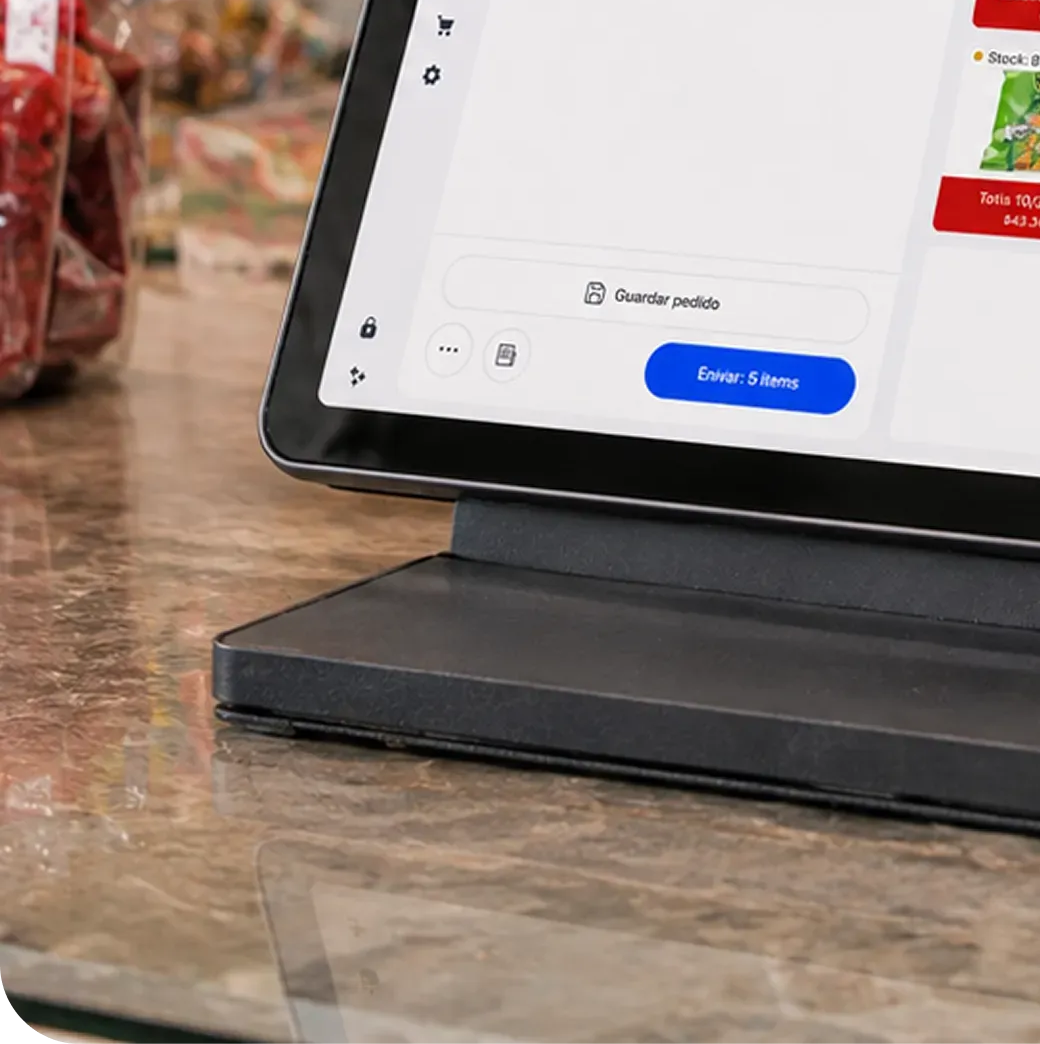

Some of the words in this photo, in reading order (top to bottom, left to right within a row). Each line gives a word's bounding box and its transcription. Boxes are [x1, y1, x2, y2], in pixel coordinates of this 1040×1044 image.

[614, 288, 671, 307] Guardar
[671, 292, 721, 312] pedido
[747, 370, 759, 386] 5
[759, 371, 800, 391] items
